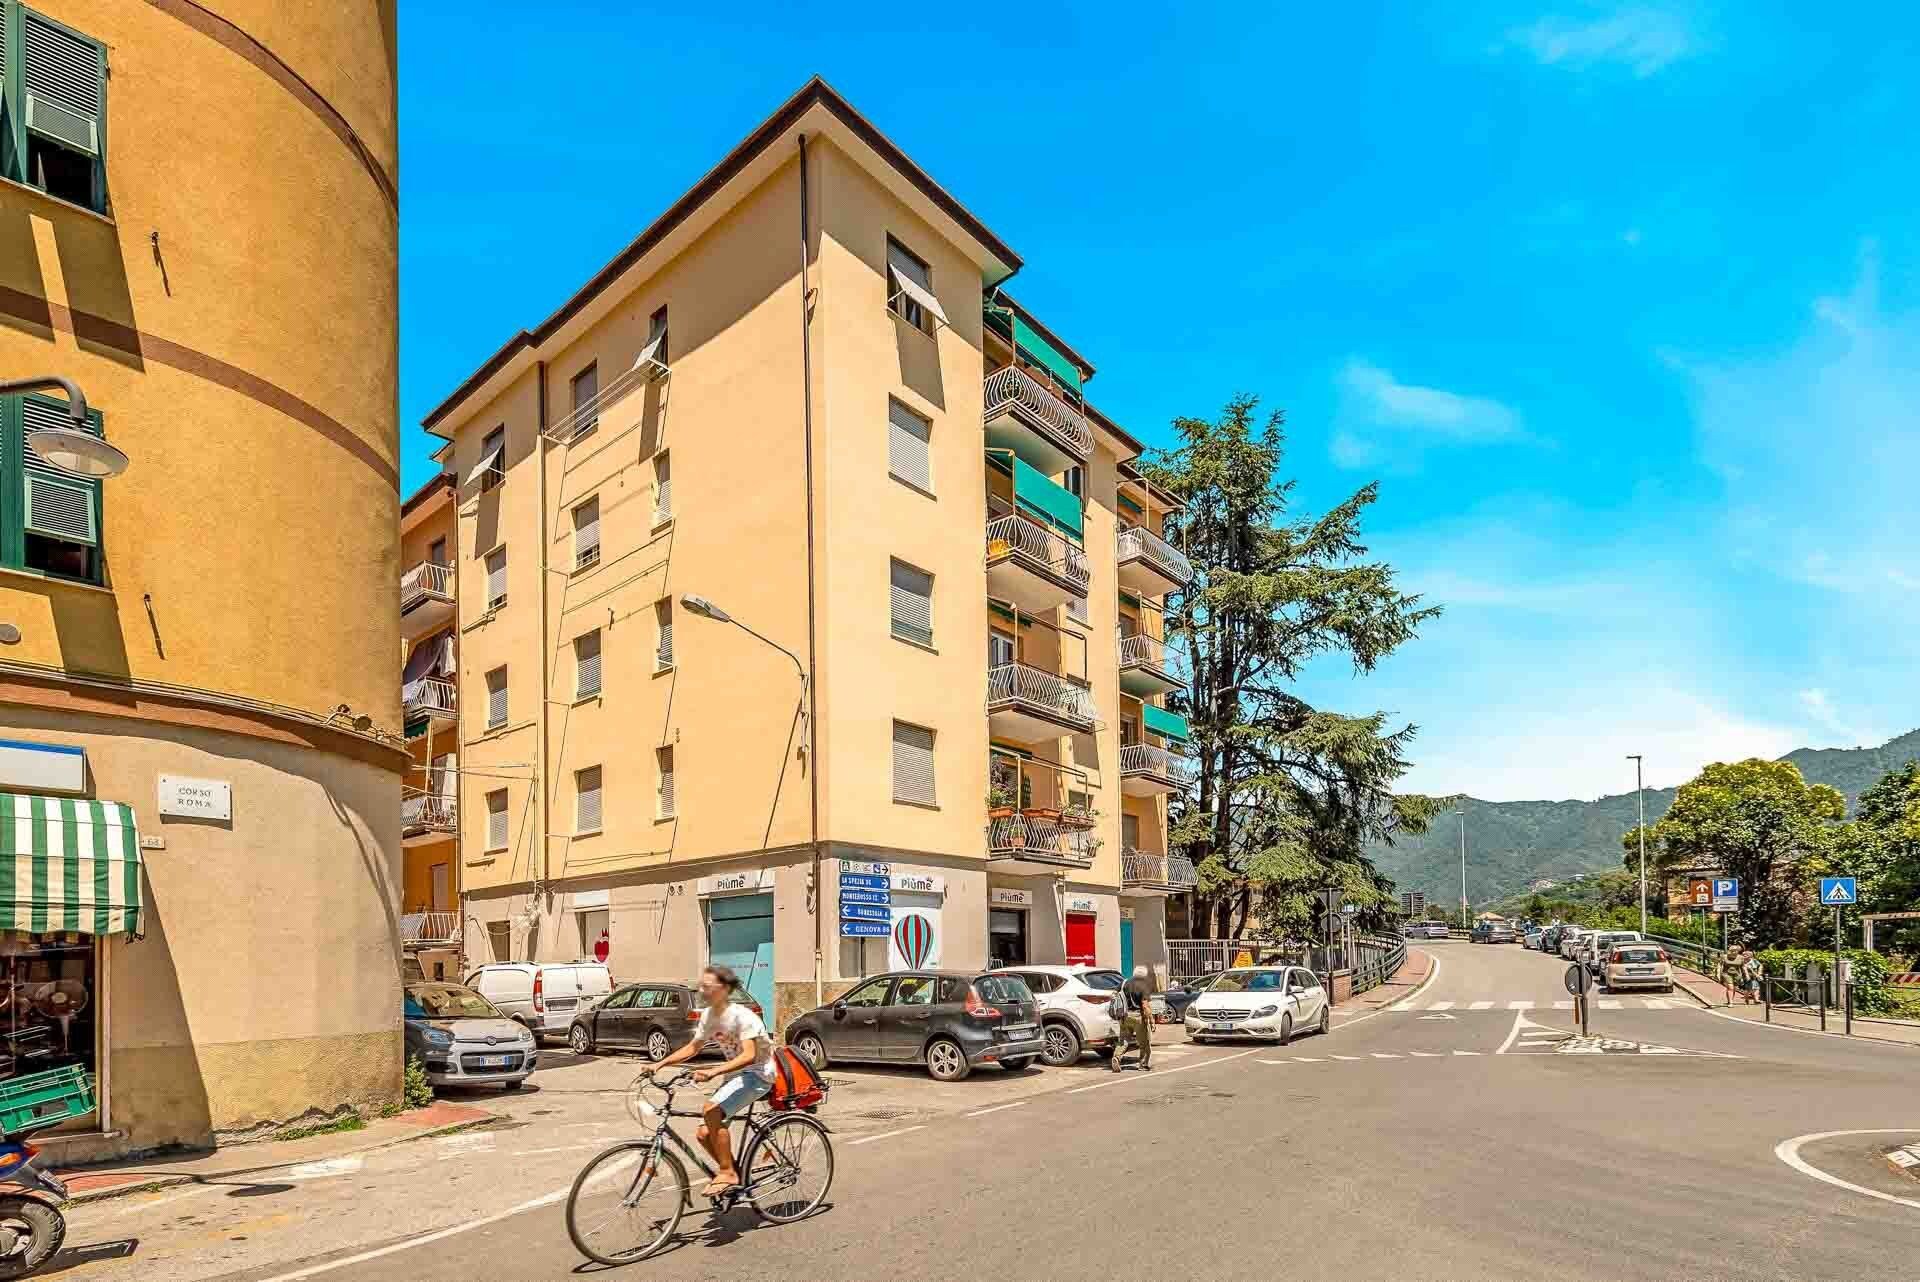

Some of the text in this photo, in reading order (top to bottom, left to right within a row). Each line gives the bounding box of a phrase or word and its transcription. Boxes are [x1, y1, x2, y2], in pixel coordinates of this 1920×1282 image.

[178, 787, 211, 797] CORSO
[178, 799, 212, 808] ROMA
[1718, 881, 1733, 896] P
[855, 925, 881, 933] GENOVA
